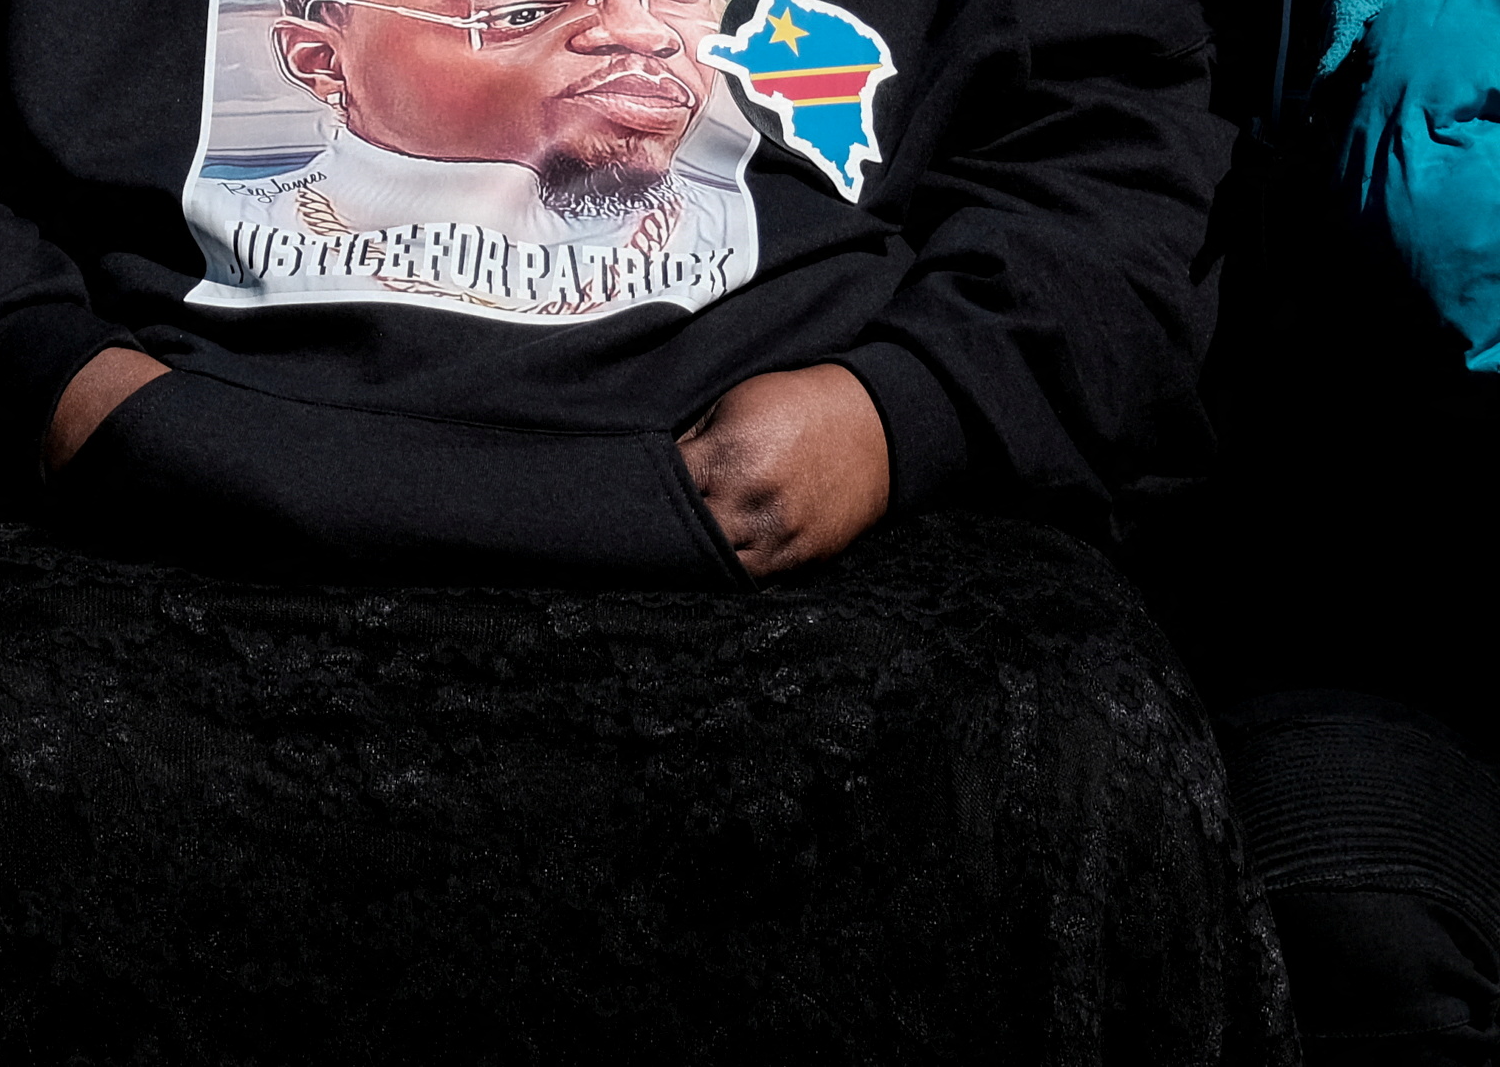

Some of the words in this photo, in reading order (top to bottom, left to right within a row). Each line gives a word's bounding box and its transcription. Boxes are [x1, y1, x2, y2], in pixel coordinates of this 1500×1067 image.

[224, 221, 419, 284] JUSTICE
[421, 222, 511, 298] FOR
[515, 240, 735, 302] PATRICK
